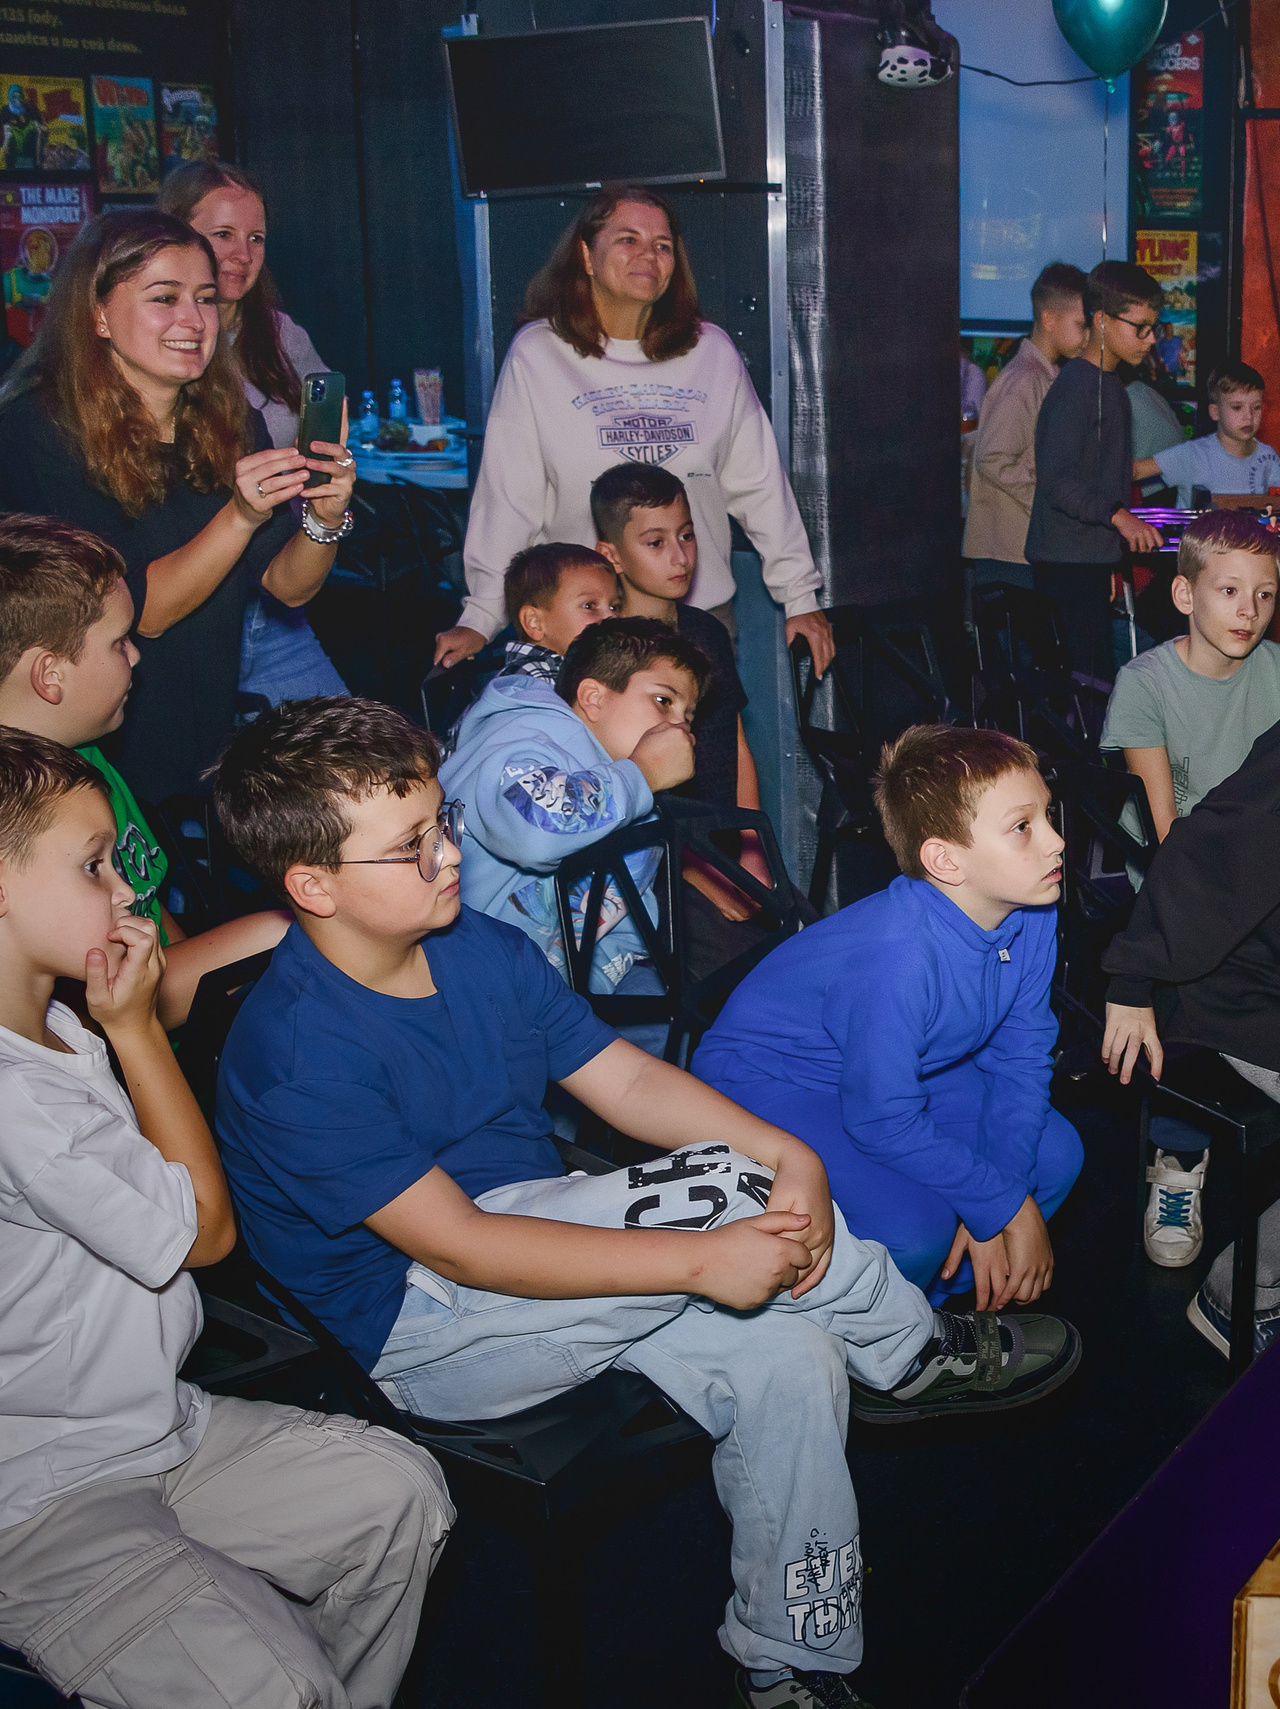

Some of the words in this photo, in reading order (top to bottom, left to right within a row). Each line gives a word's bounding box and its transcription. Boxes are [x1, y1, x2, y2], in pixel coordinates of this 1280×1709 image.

[19, 186, 43, 205] THE
[45, 186, 79, 205] MARS
[622, 416, 668, 428] MOTOR
[605, 427, 692, 443] HARLEY-DAVIDSON
[627, 444, 673, 465] CYCLES
